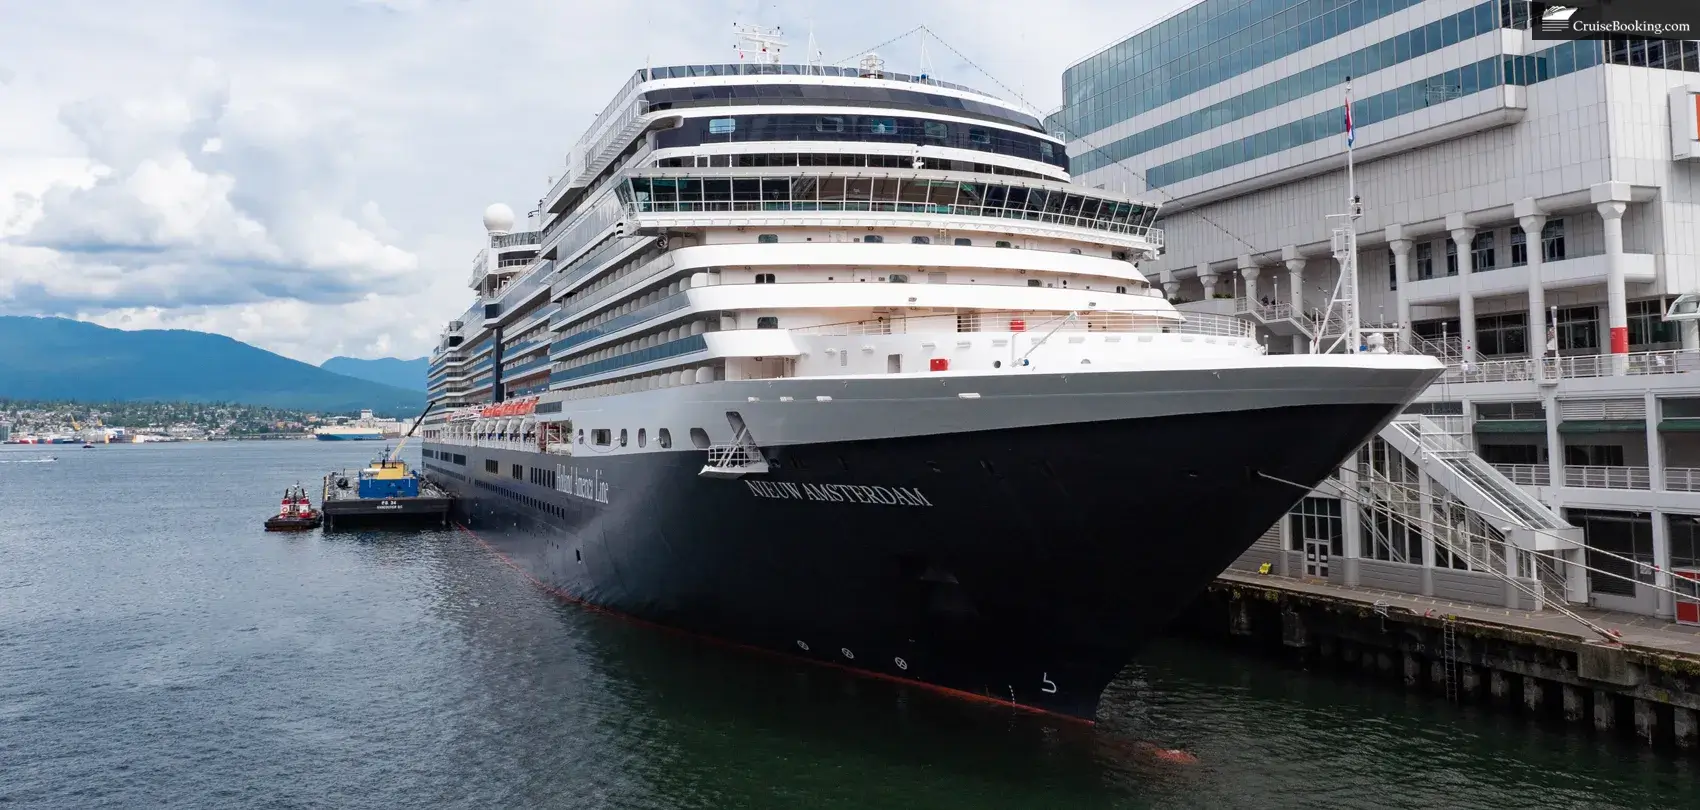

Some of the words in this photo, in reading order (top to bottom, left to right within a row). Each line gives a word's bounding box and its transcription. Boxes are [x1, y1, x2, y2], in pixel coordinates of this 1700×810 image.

[556, 463, 573, 495] Holland
[574, 466, 593, 500] America
[595, 469, 609, 505] Line
[744, 479, 803, 500] NIEUW
[802, 482, 934, 507] AMSTERDAM
